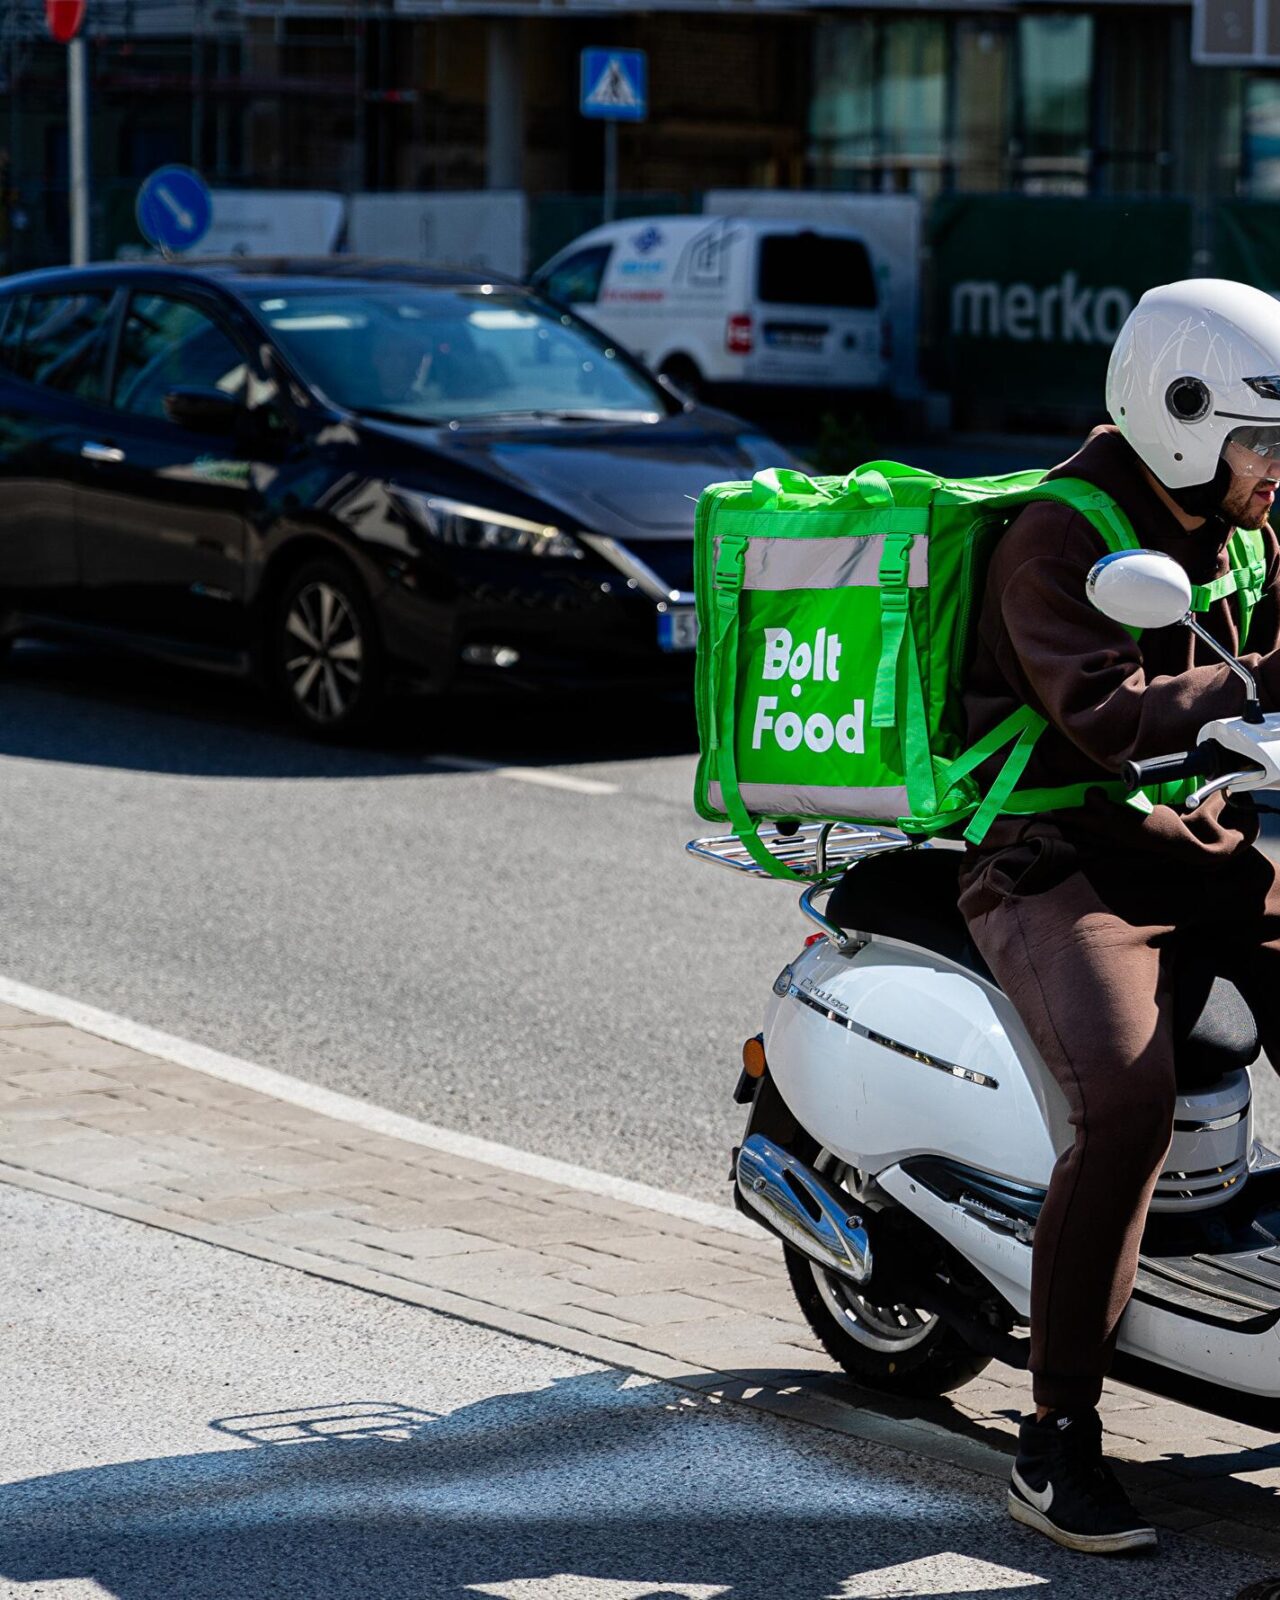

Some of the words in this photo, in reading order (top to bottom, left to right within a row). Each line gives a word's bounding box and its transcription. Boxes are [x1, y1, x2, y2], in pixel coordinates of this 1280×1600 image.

[953, 271, 1133, 343] merko
[762, 627, 842, 682] Bolt
[752, 696, 865, 754] Food
